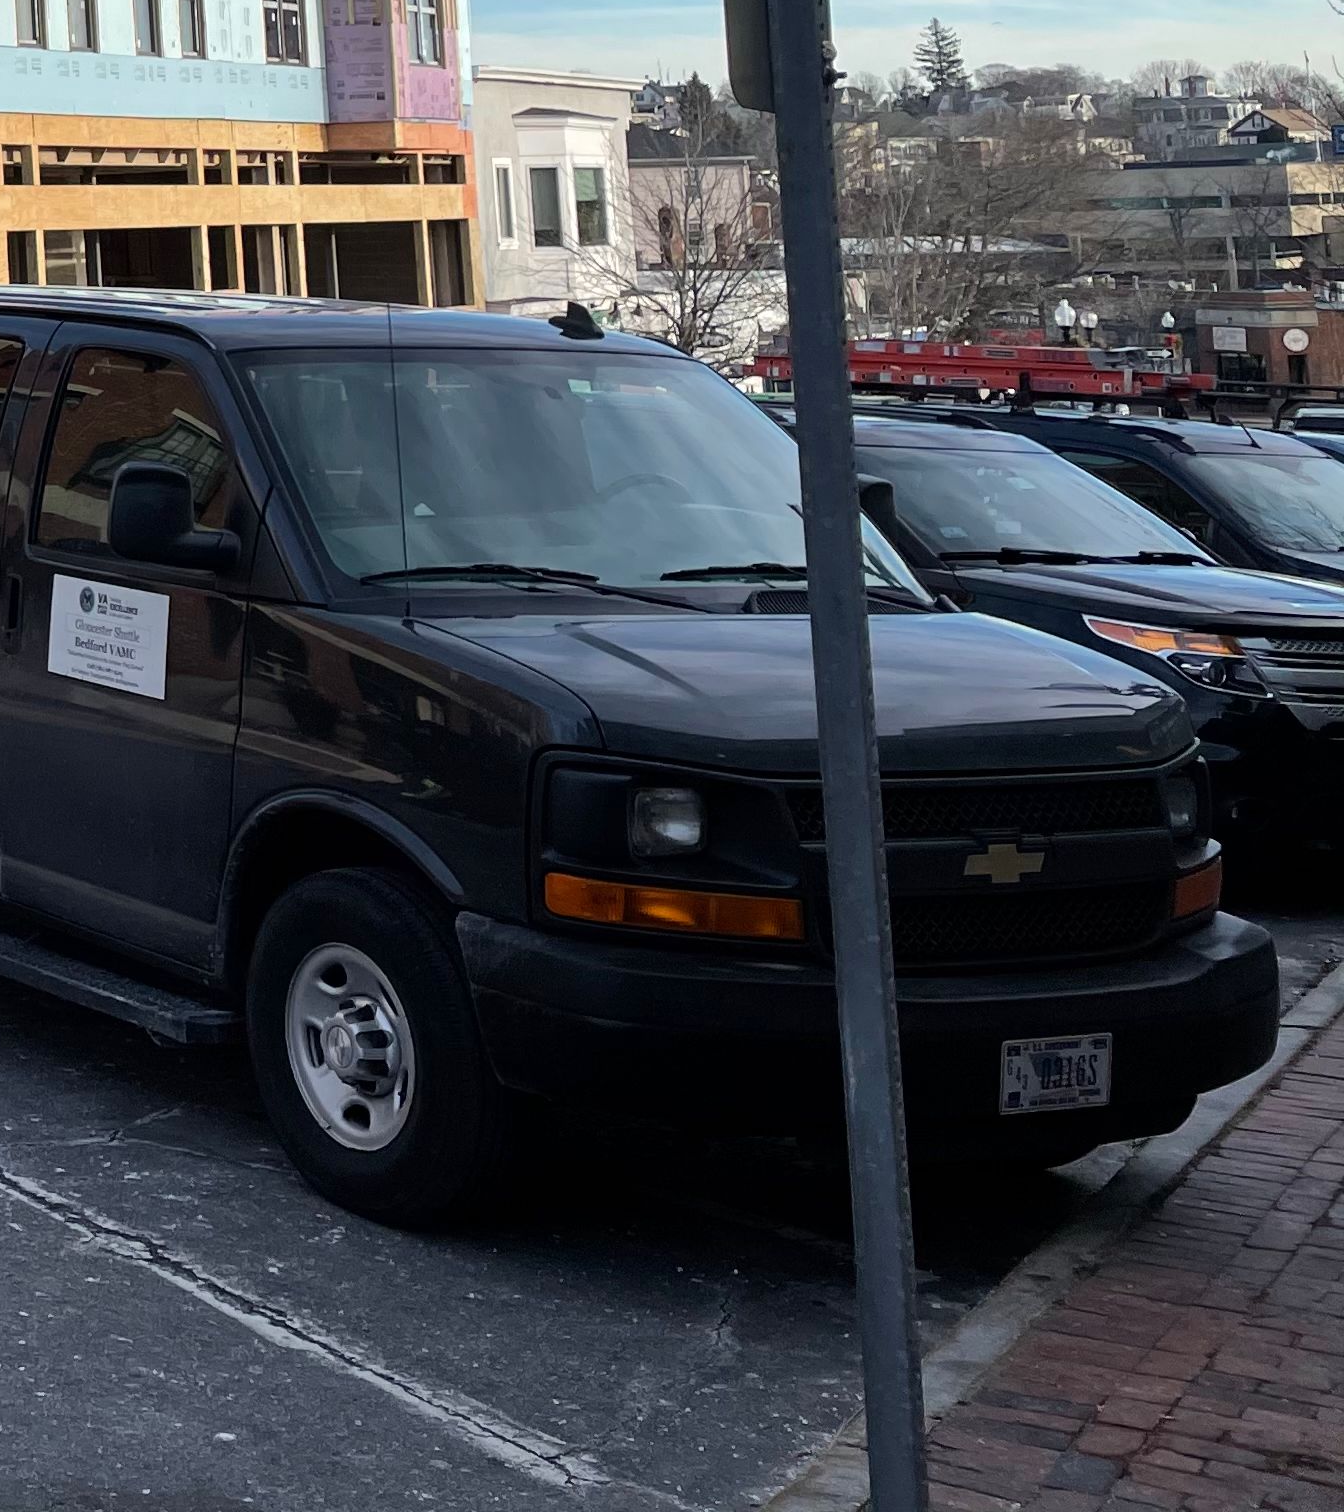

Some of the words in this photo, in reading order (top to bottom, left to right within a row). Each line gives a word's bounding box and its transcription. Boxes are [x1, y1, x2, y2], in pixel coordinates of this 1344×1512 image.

[97, 592, 109, 604] VA
[75, 618, 113, 637] Gloucester
[114, 626, 141, 643] Shuttle
[75, 636, 108, 654] Bedford
[109, 644, 137, 660] VAMC
